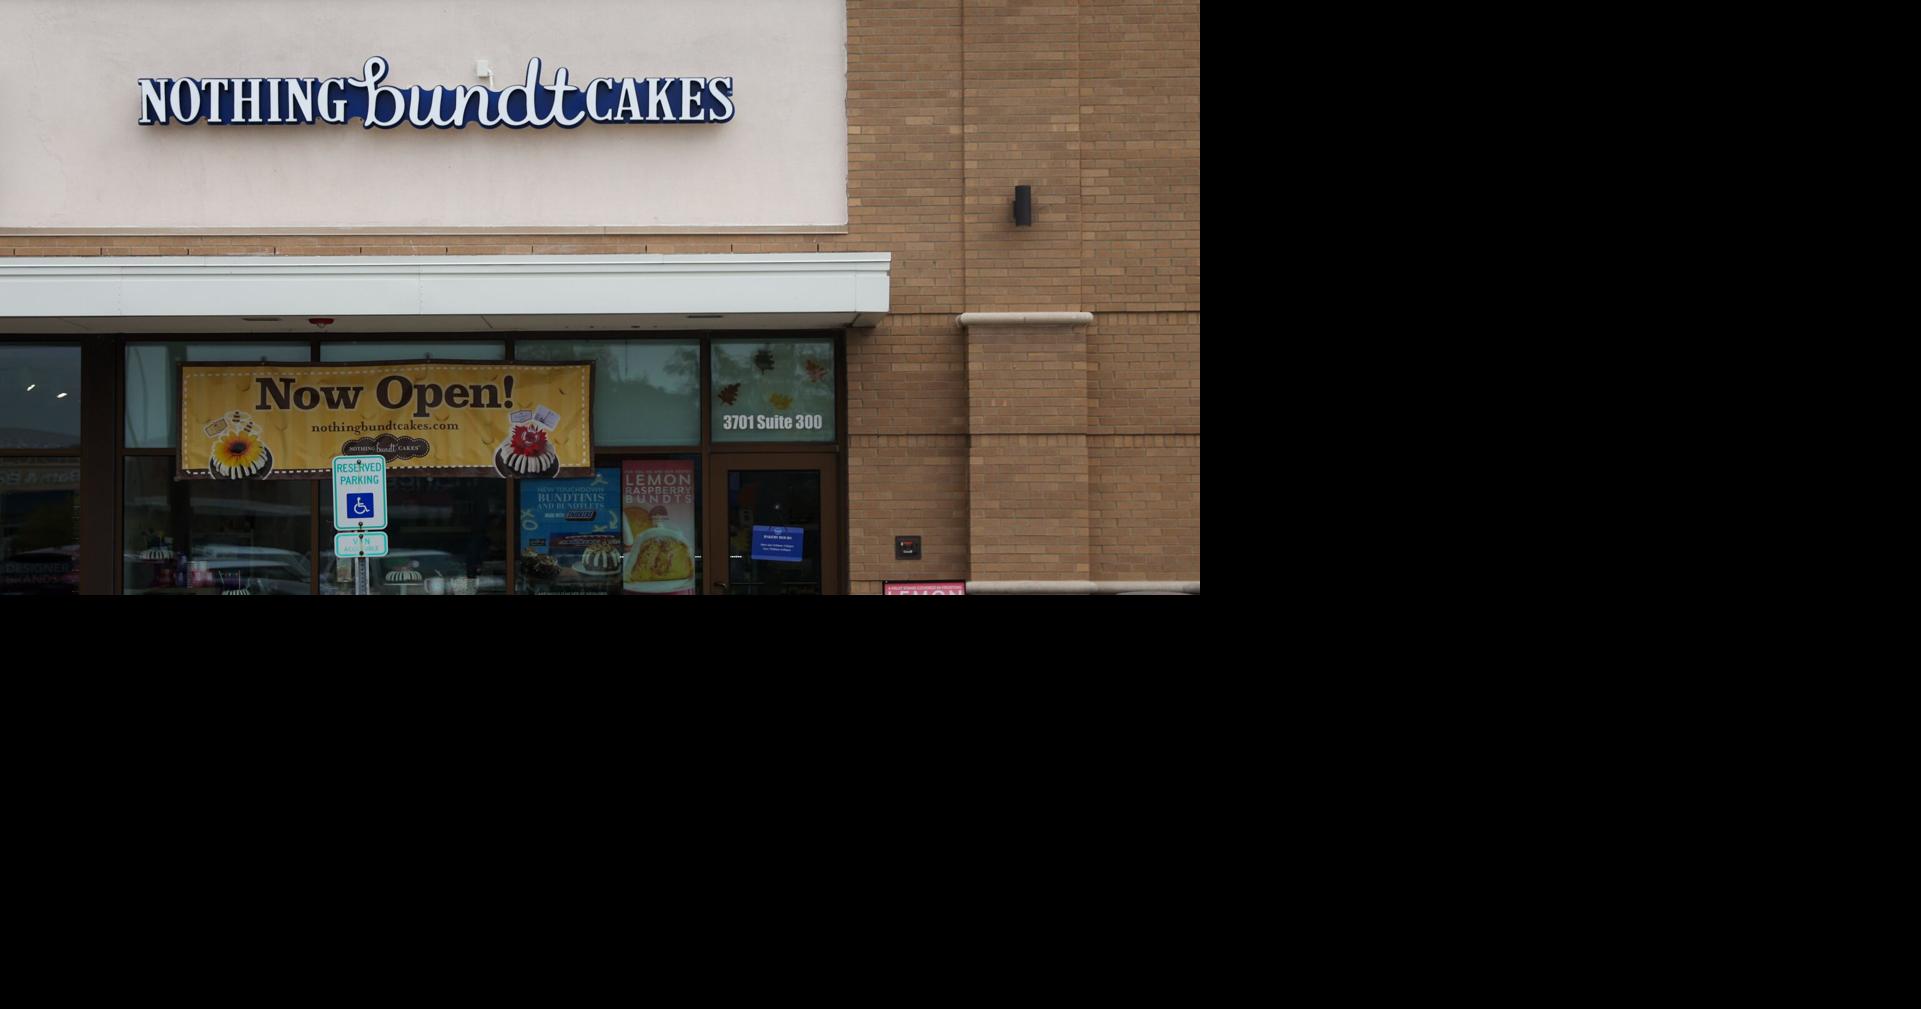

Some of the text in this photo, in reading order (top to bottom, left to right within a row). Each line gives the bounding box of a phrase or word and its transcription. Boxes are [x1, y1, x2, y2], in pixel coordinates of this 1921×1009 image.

[138, 55, 735, 129] NOTHING bundt CAKES
[255, 375, 515, 418] Now Open!
[311, 420, 459, 435] nothingbundtcakes.com
[723, 414, 823, 430] 3701 Suite 300
[336, 462, 382, 473] RESERVED
[340, 475, 379, 485] PARKING
[625, 473, 692, 486] LEMON
[625, 486, 692, 495] RASPBERRY
[538, 493, 605, 502] BUNDTINIS
[625, 495, 692, 504] BUNDTS
